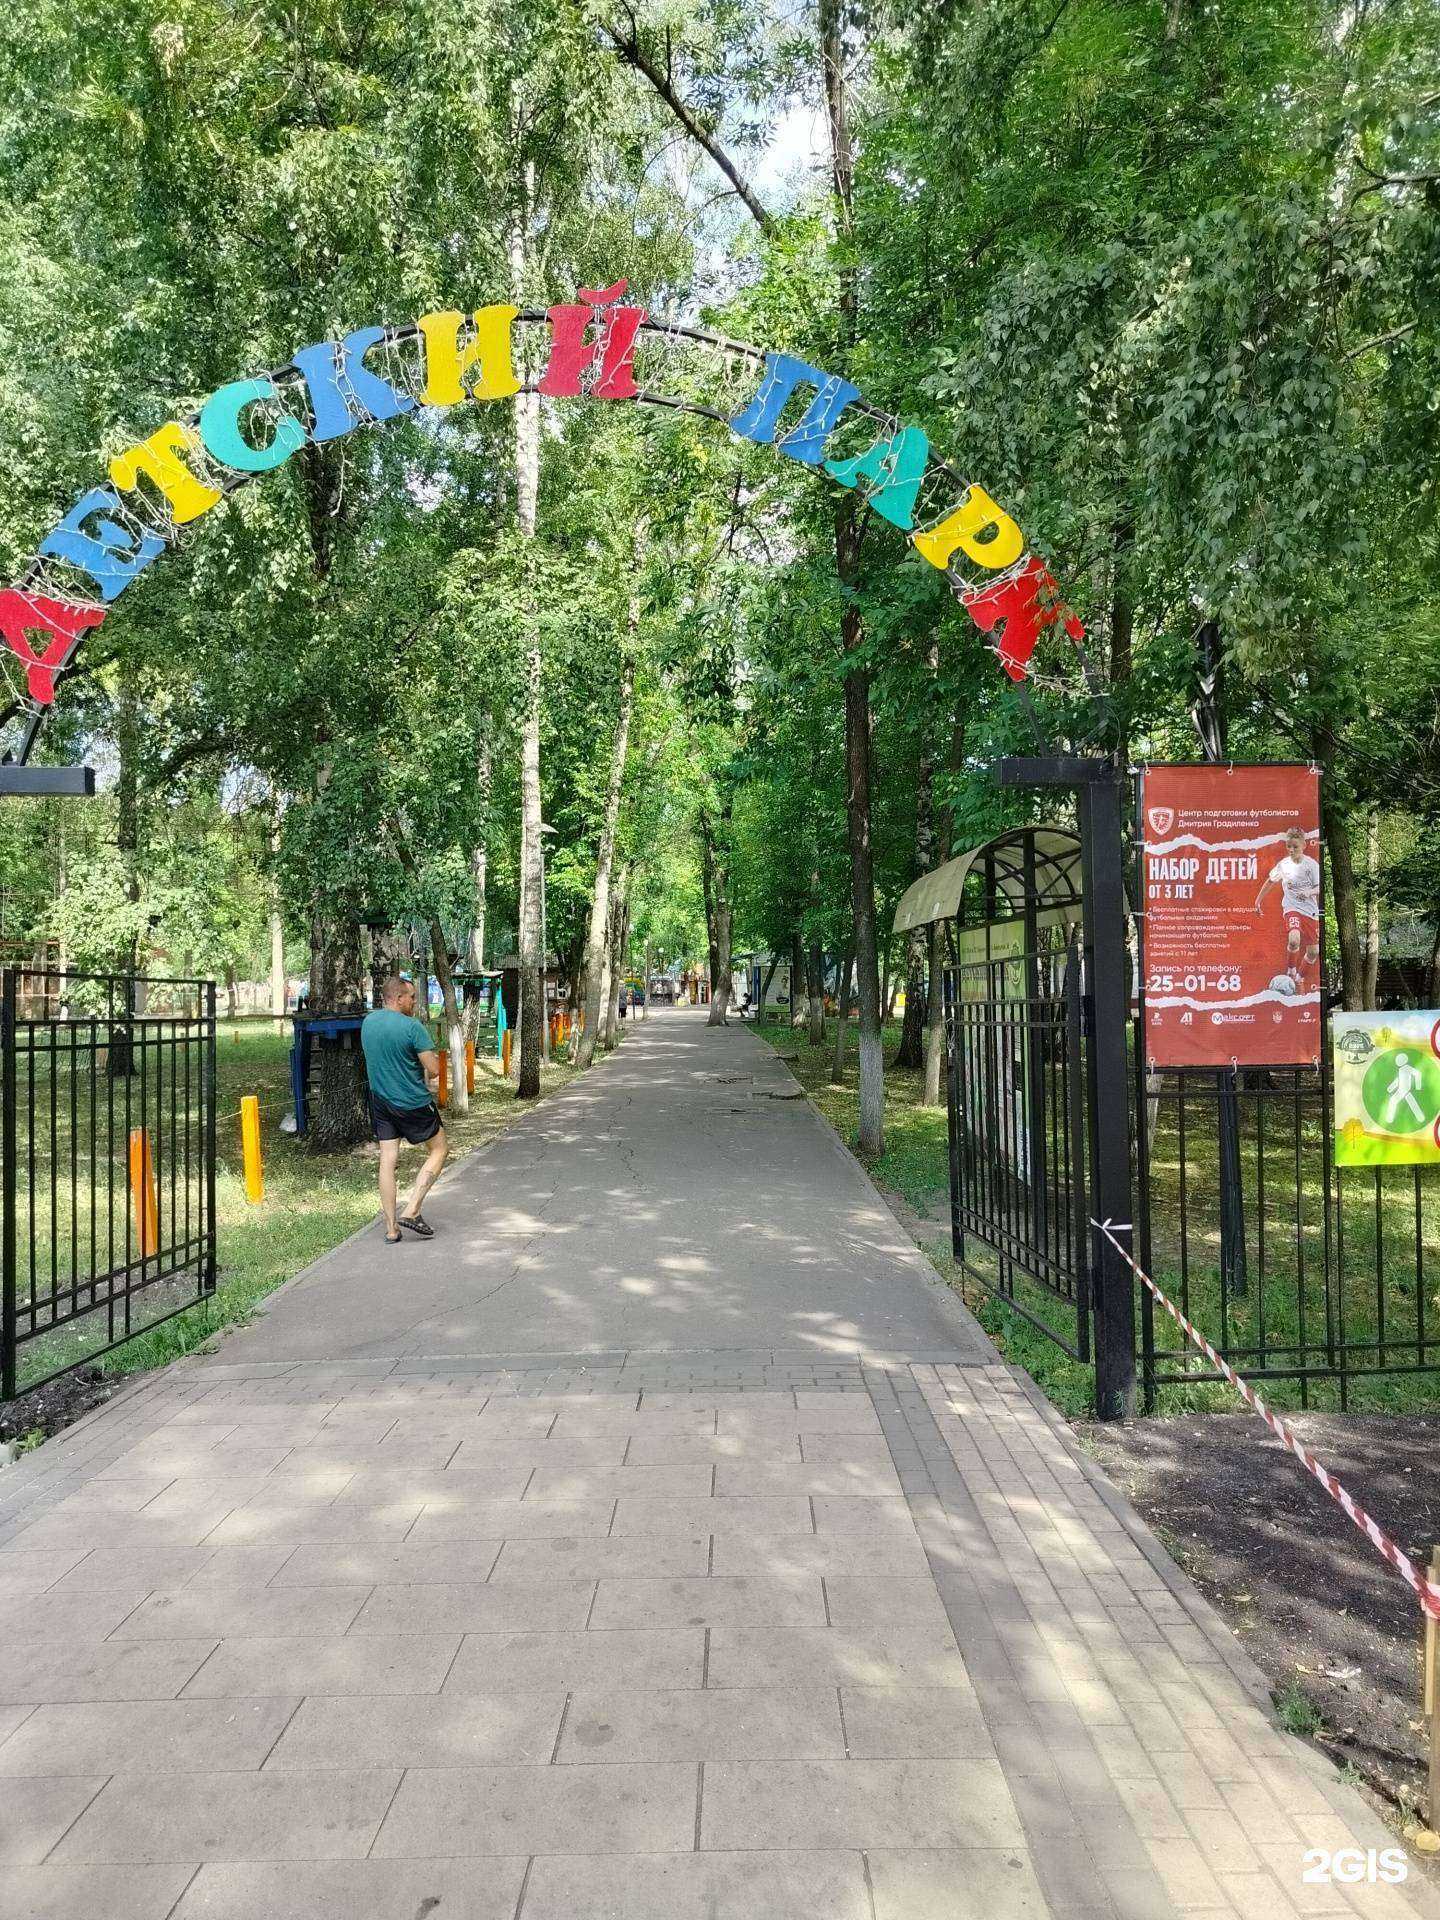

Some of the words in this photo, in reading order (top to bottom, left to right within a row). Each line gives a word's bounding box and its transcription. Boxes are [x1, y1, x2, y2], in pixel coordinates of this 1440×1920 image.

[0, 278, 648, 705] ДЕТСКИЙ
[729, 354, 1085, 682] ПАРК
[1178, 809, 1202, 818] Центр
[1204, 810, 1248, 818] подготовки
[1250, 808, 1300, 818] футболистов
[1178, 819, 1212, 828] Дмитрия
[1149, 857, 1200, 880] НАБОР
[1205, 853, 1258, 884] ДЕТЕЙ
[1148, 884, 1162, 899] ОТ
[1164, 884, 1172, 899] 3
[1174, 884, 1194, 899] ЛЕТ
[1149, 963, 1182, 973] Запись
[1183, 965, 1196, 973] по
[1197, 963, 1242, 974] телефону:
[1150, 974, 1242, 992] 25-01-68
